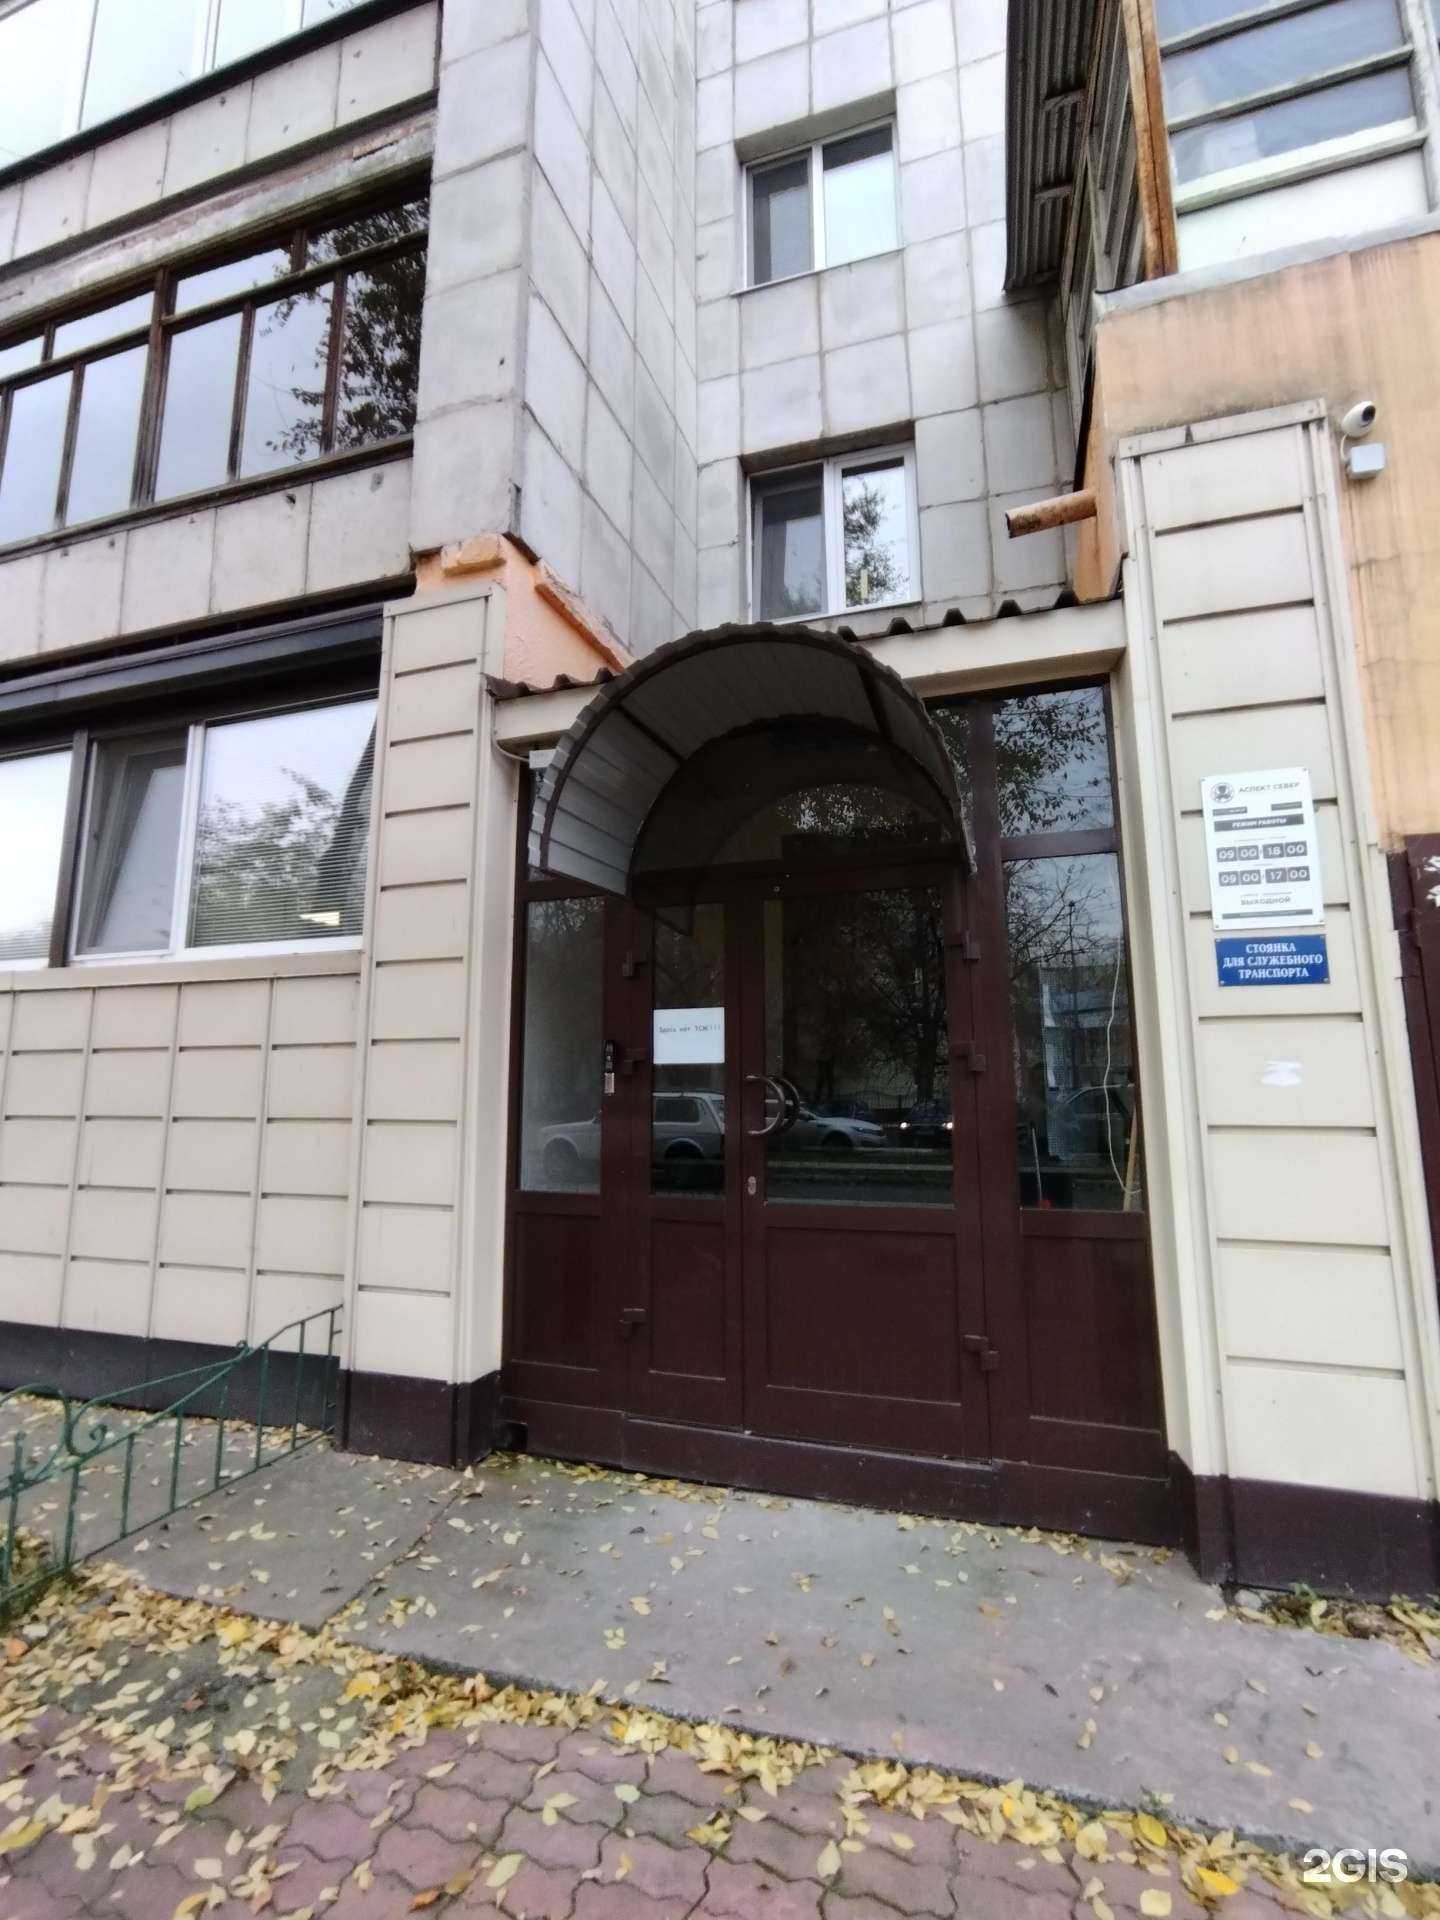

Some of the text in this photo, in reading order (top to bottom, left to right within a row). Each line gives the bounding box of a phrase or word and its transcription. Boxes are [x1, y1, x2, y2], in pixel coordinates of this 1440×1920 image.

[1218, 844, 1305, 860] 09 00 18 00
[1220, 869, 1308, 884] 09 00 17 00
[1245, 942, 1296, 953] СТОЯНКА
[1222, 954, 1323, 968] ДЛЯ СЛУЖЕБНОГО
[1238, 967, 1309, 979] ТРАНСПОРТА
